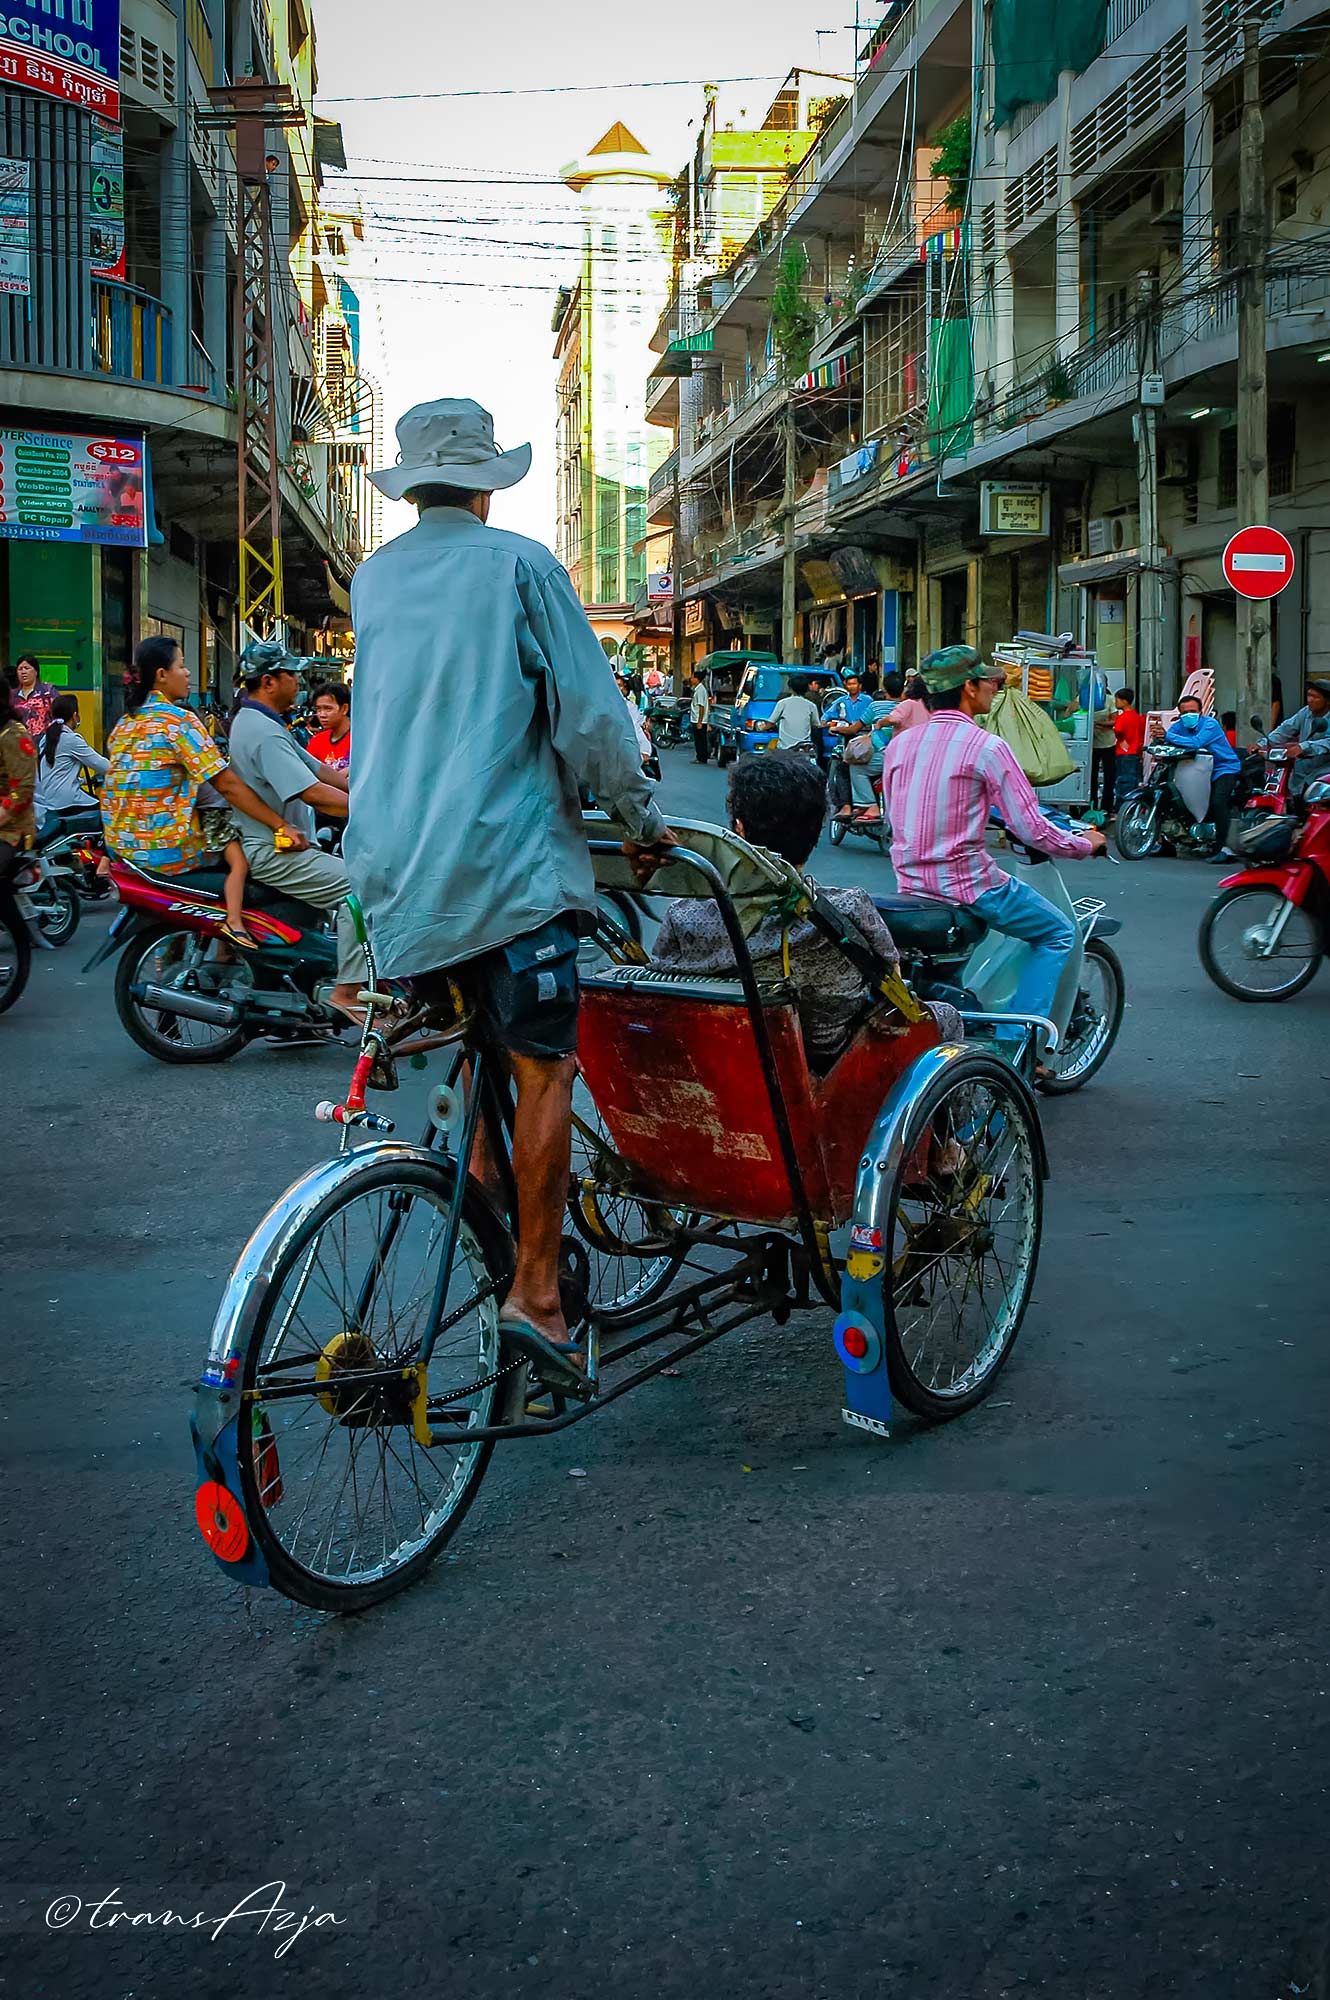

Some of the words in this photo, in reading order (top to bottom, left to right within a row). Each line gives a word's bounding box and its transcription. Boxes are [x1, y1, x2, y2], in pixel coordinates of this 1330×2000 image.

[93, 444, 135, 461] $12
[18, 482, 70, 492] WebDesign
[40, 515, 69, 524] Repair
[168, 902, 228, 921] Viva
